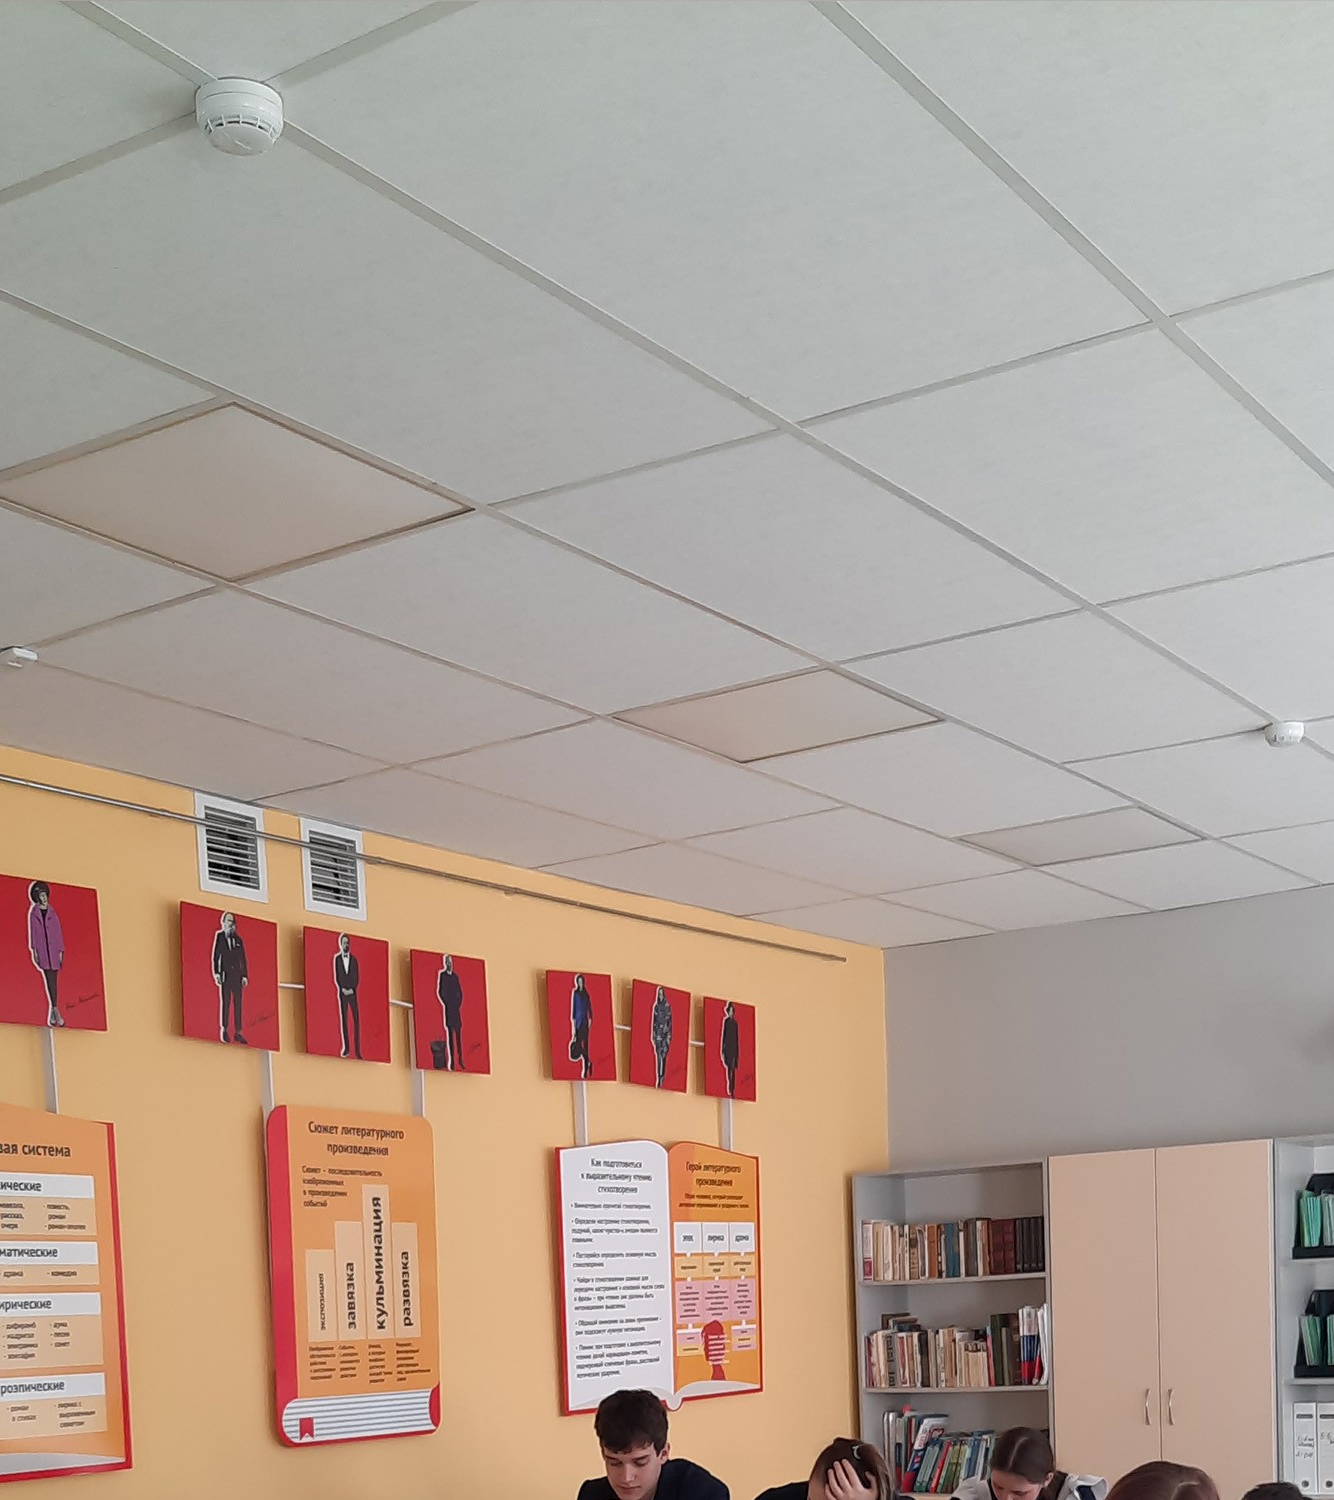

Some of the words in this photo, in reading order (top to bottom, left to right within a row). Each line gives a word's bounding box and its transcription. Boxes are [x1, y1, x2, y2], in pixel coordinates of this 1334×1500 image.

[22, 1144, 71, 1157] система
[308, 1121, 339, 1134] Сюжет
[341, 1126, 404, 1141] литературного
[327, 1144, 389, 1156] произведения
[372, 1197, 388, 1330] кульминация
[346, 1263, 356, 1330] завязка
[401, 1252, 413, 1326] развязка
